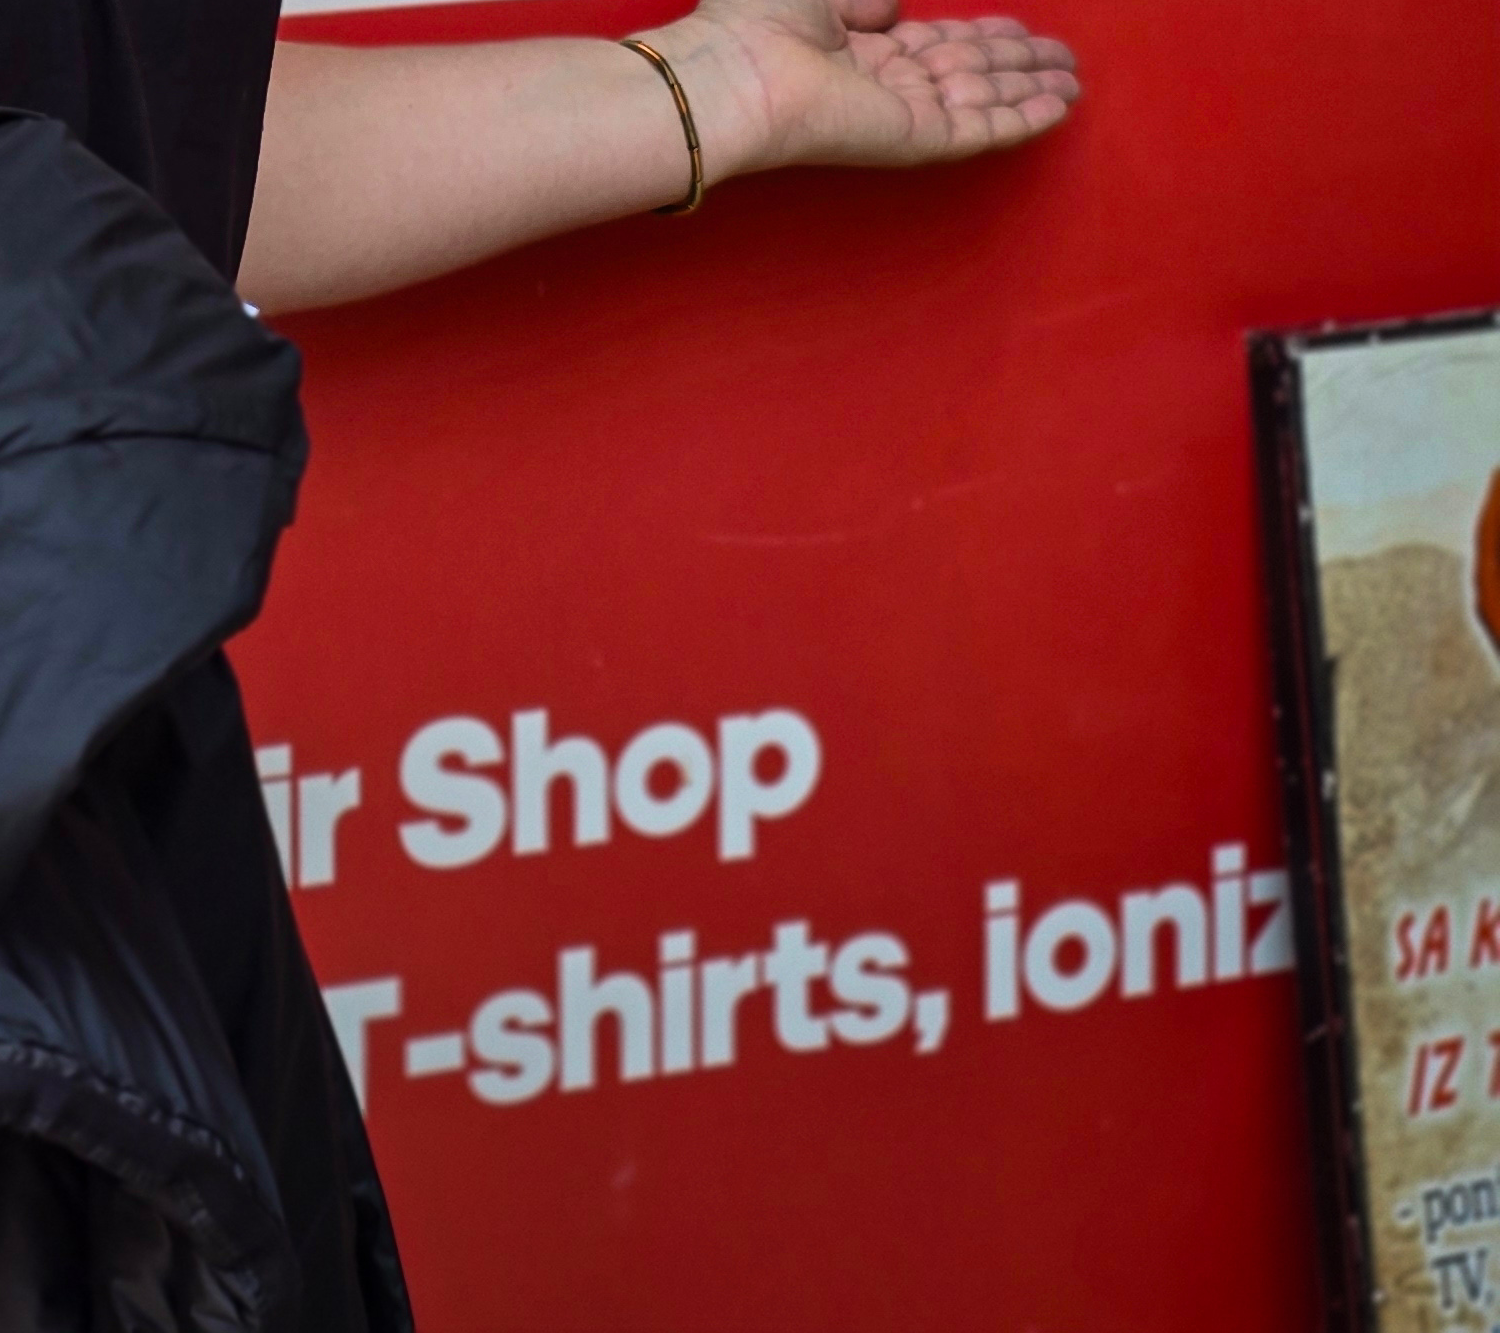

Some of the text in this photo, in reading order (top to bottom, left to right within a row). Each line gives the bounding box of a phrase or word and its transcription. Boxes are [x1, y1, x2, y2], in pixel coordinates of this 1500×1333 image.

[399, 708, 822, 869] Shop
[319, 841, 1297, 1119] T-shirts, ioniz
[1396, 904, 1452, 981] SA
[1408, 1036, 1465, 1118] IZ
